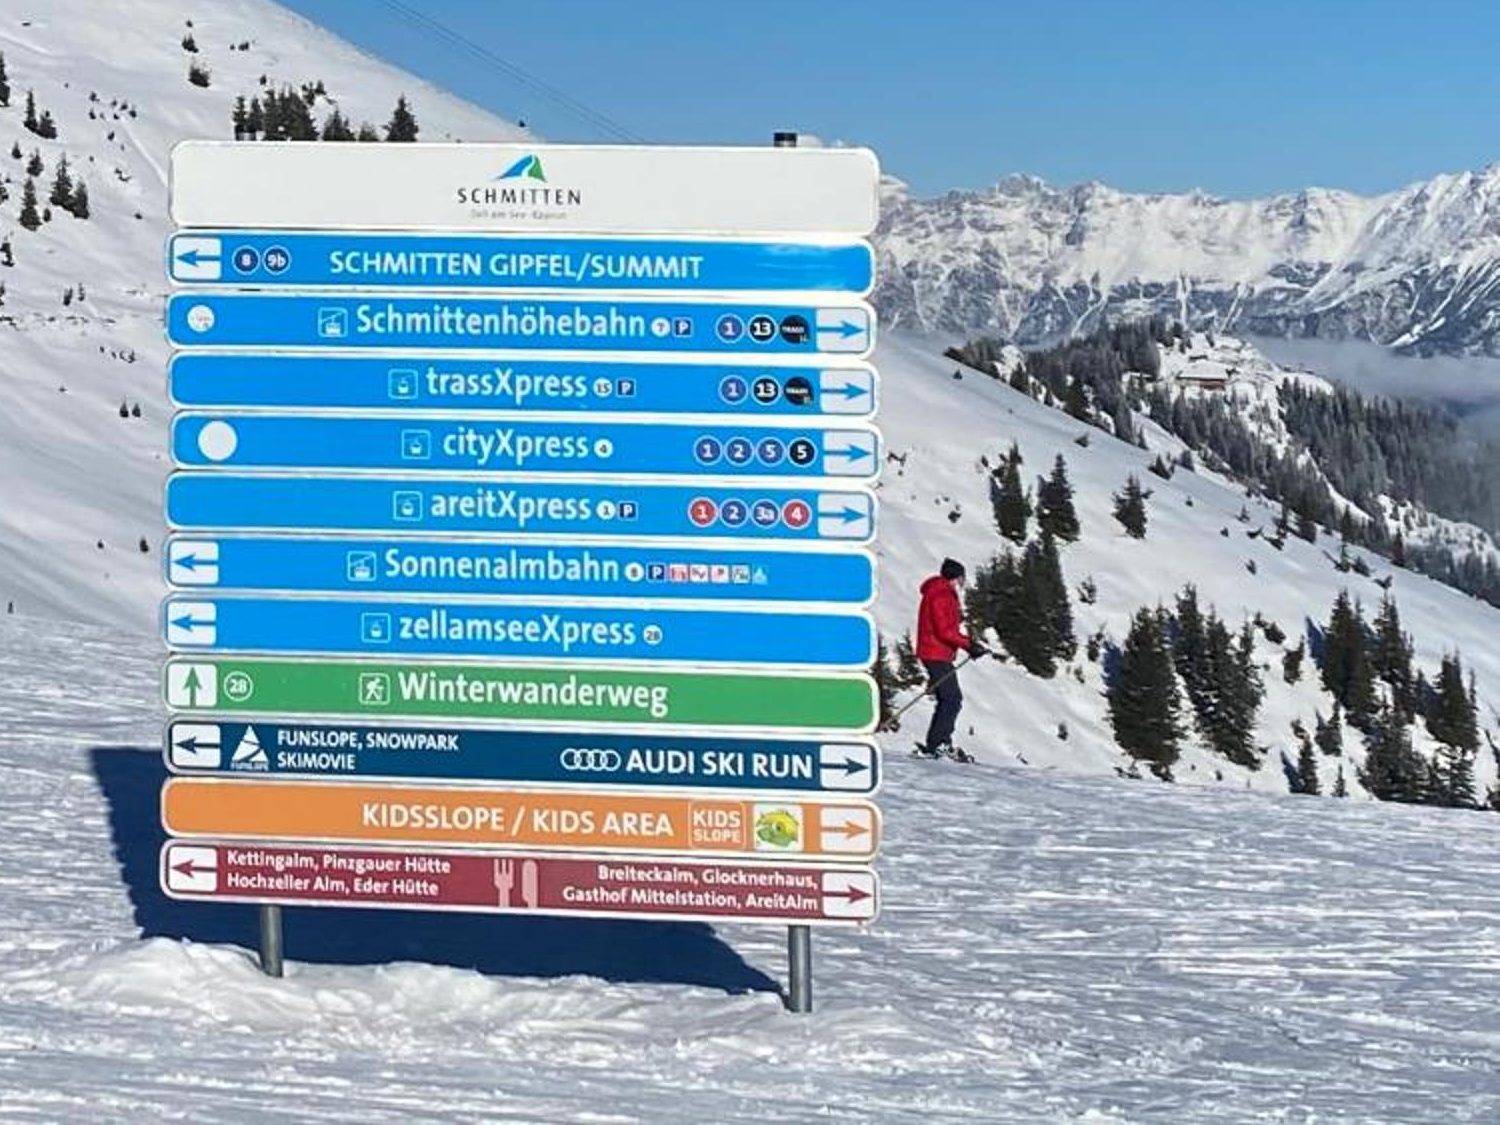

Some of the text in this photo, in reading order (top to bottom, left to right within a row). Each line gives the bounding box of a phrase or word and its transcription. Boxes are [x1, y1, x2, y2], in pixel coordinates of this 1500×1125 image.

[457, 188, 581, 206] SCHMITTEN
[267, 253, 285, 267] 9b
[330, 251, 481, 274] SCHMITTEN
[490, 252, 704, 281] GIPFEL/SUMMIT
[357, 305, 644, 337] Schmittenhöhebahn
[753, 323, 772, 335] 13
[426, 366, 587, 405] trassXpress
[756, 383, 776, 397] 13
[443, 427, 589, 465] cityXpress
[431, 490, 589, 527] areitXpress
[757, 507, 774, 520] 3a
[386, 549, 617, 580] Sonnenalmbahn
[399, 610, 635, 650] zellamseeXpress
[229, 672, 668, 717] 28 Winterwanderweg
[277, 730, 459, 751] FUNSLOPE, SNOWPARK
[277, 754, 356, 770] SKIMOVIE
[626, 749, 813, 777] AUDI SKI RUN
[363, 804, 504, 830] KIDSSLOPE
[533, 810, 595, 833] KIDS
[603, 811, 674, 836] AREA
[693, 809, 741, 827] KIDS
[693, 829, 741, 843] SLOPE
[227, 851, 451, 873] Kettingalm, Pinzgauer Hütte
[227, 874, 439, 896] Hochzeller Alm, Eder Hütte
[598, 864, 817, 890] Breiteckalm, Glocknerhaus,
[563, 887, 817, 910] Gasthof Mittelstation, AreitAlm
